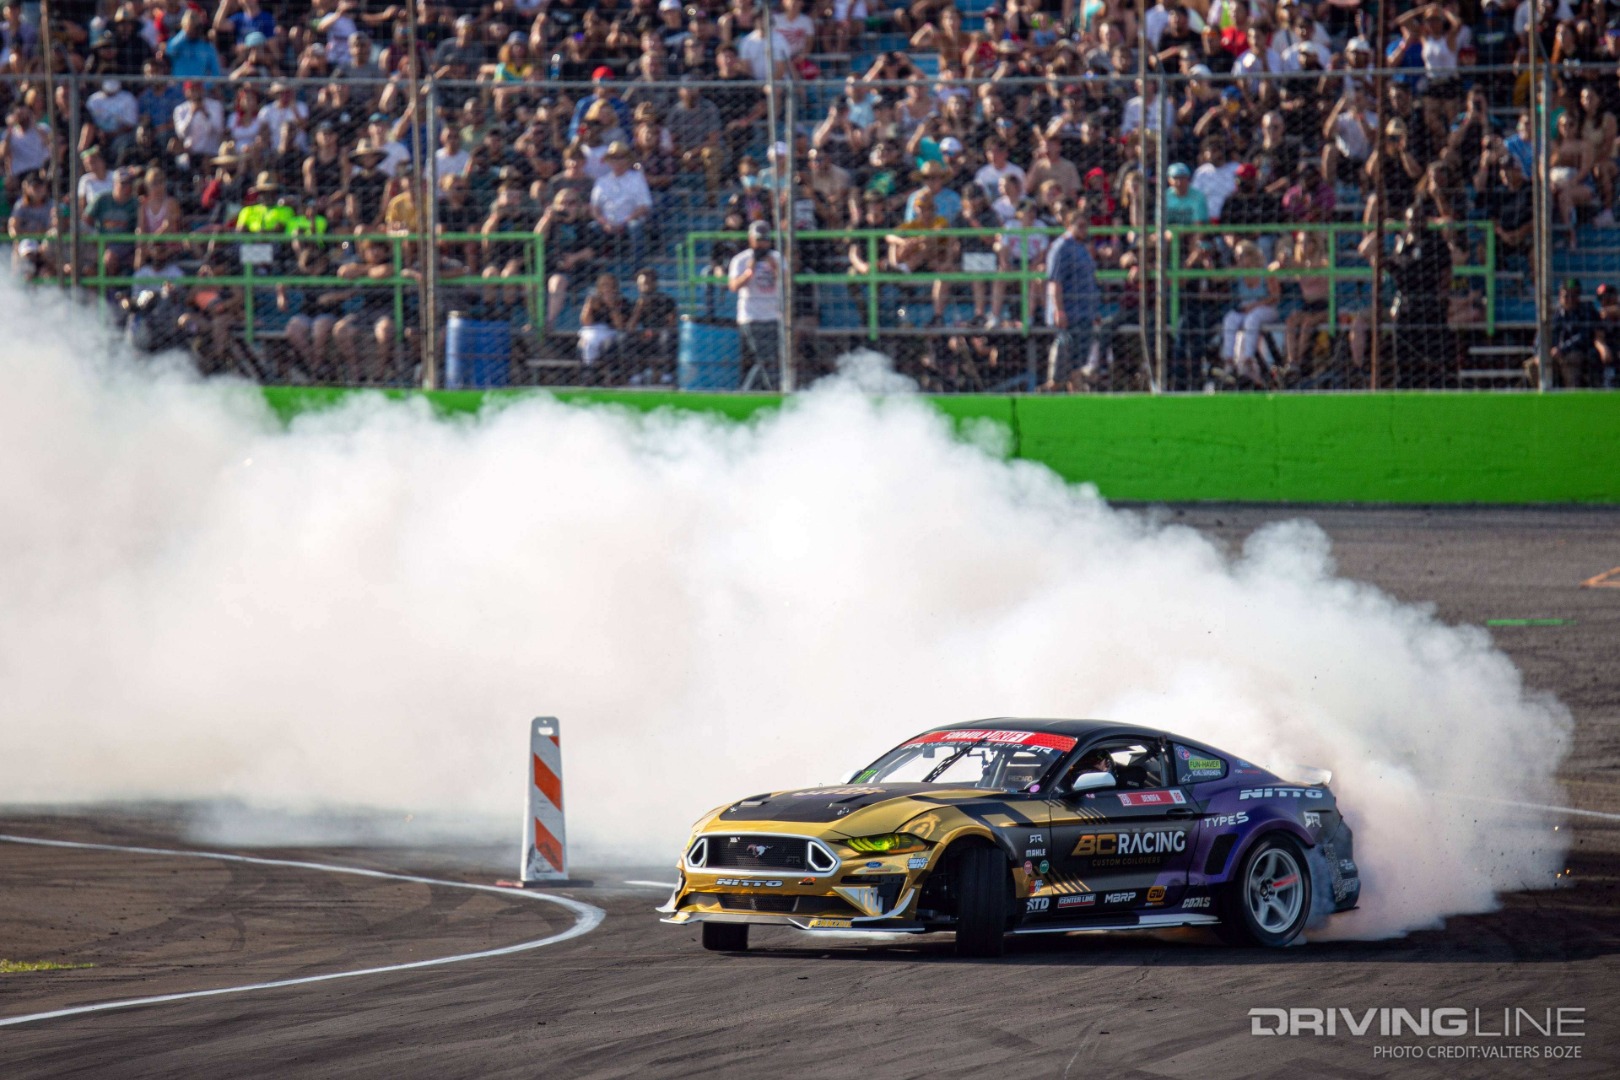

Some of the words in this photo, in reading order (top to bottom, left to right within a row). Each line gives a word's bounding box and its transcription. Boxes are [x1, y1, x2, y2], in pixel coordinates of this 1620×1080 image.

[986, 731, 1035, 743] DRIFT
[1239, 788, 1323, 800] NITTO
[1025, 848, 1046, 858] MAHLE
[1092, 858, 1121, 867] CUSTOM
[716, 878, 783, 887] NITTO
[1104, 892, 1137, 904] MBRP
